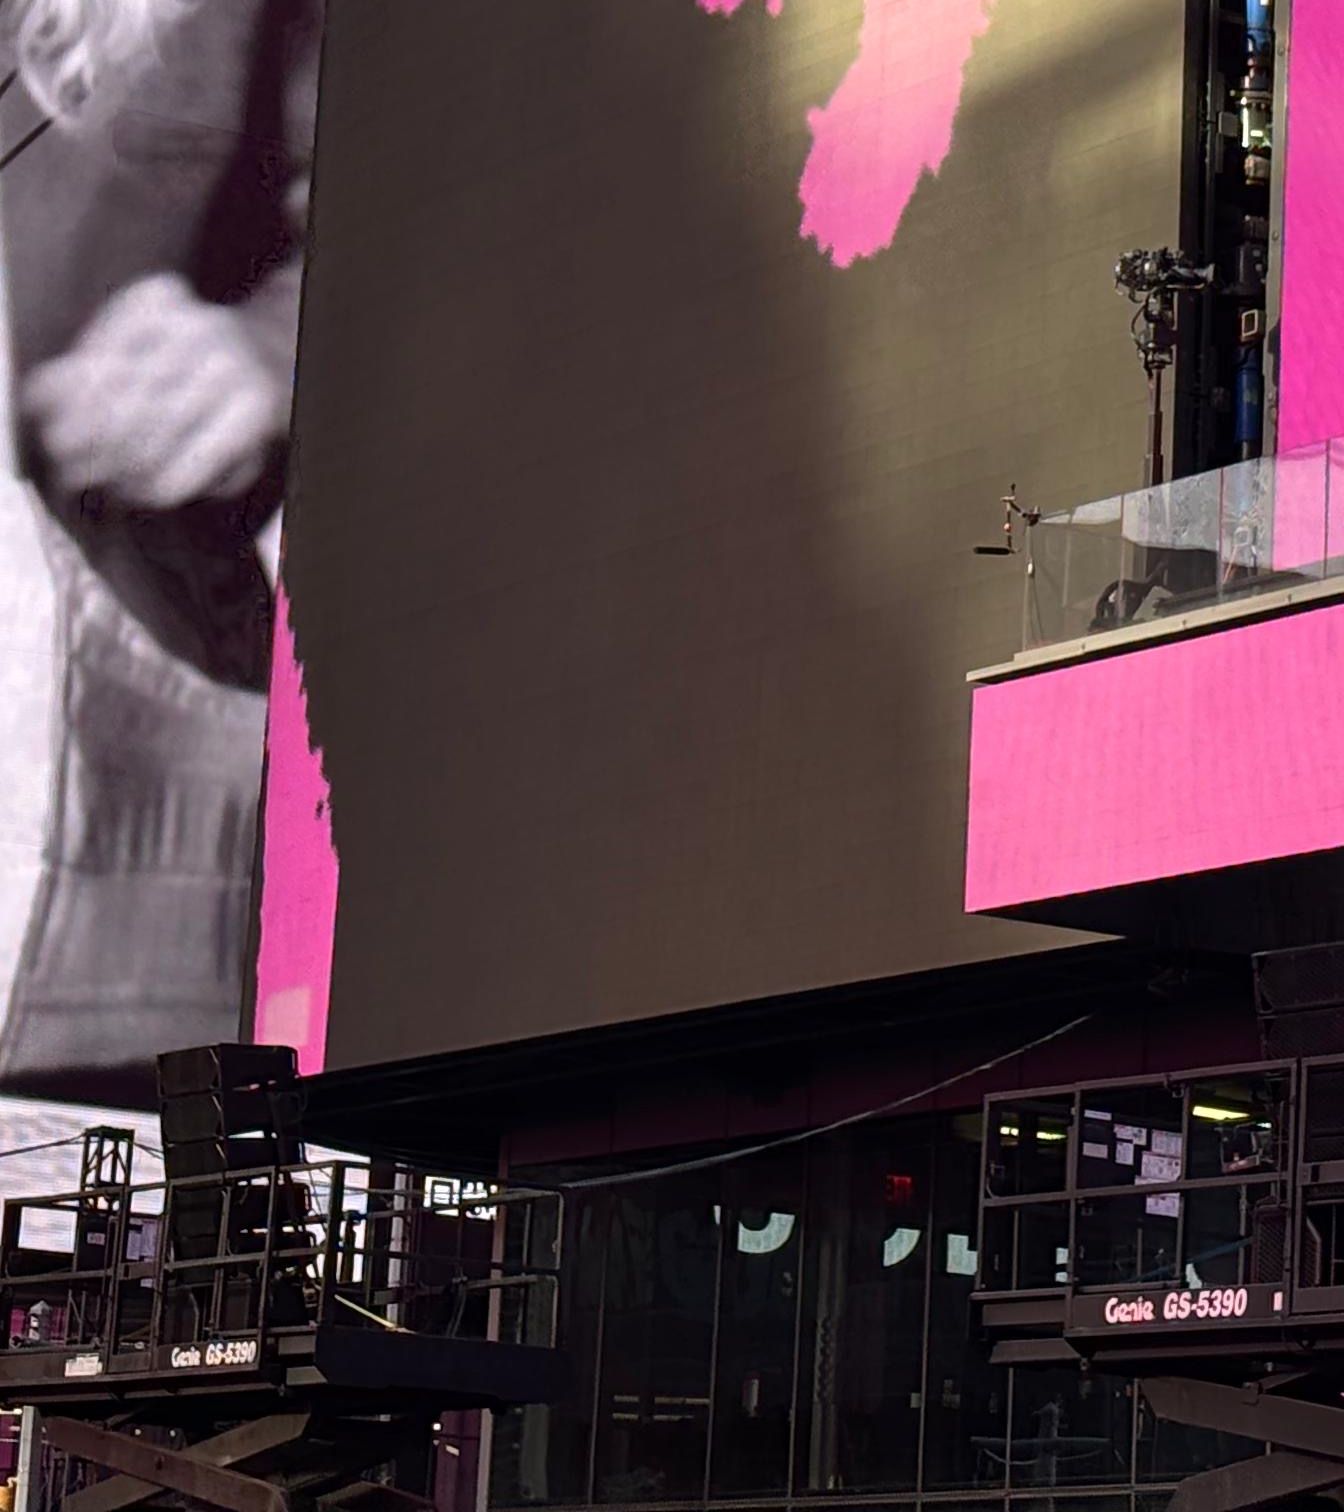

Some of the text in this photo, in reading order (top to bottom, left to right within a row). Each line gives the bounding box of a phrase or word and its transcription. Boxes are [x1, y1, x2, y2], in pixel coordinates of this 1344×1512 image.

[1105, 1288, 1248, 1324] Genie GS-5390
[206, 1340, 257, 1366] GS-5390
